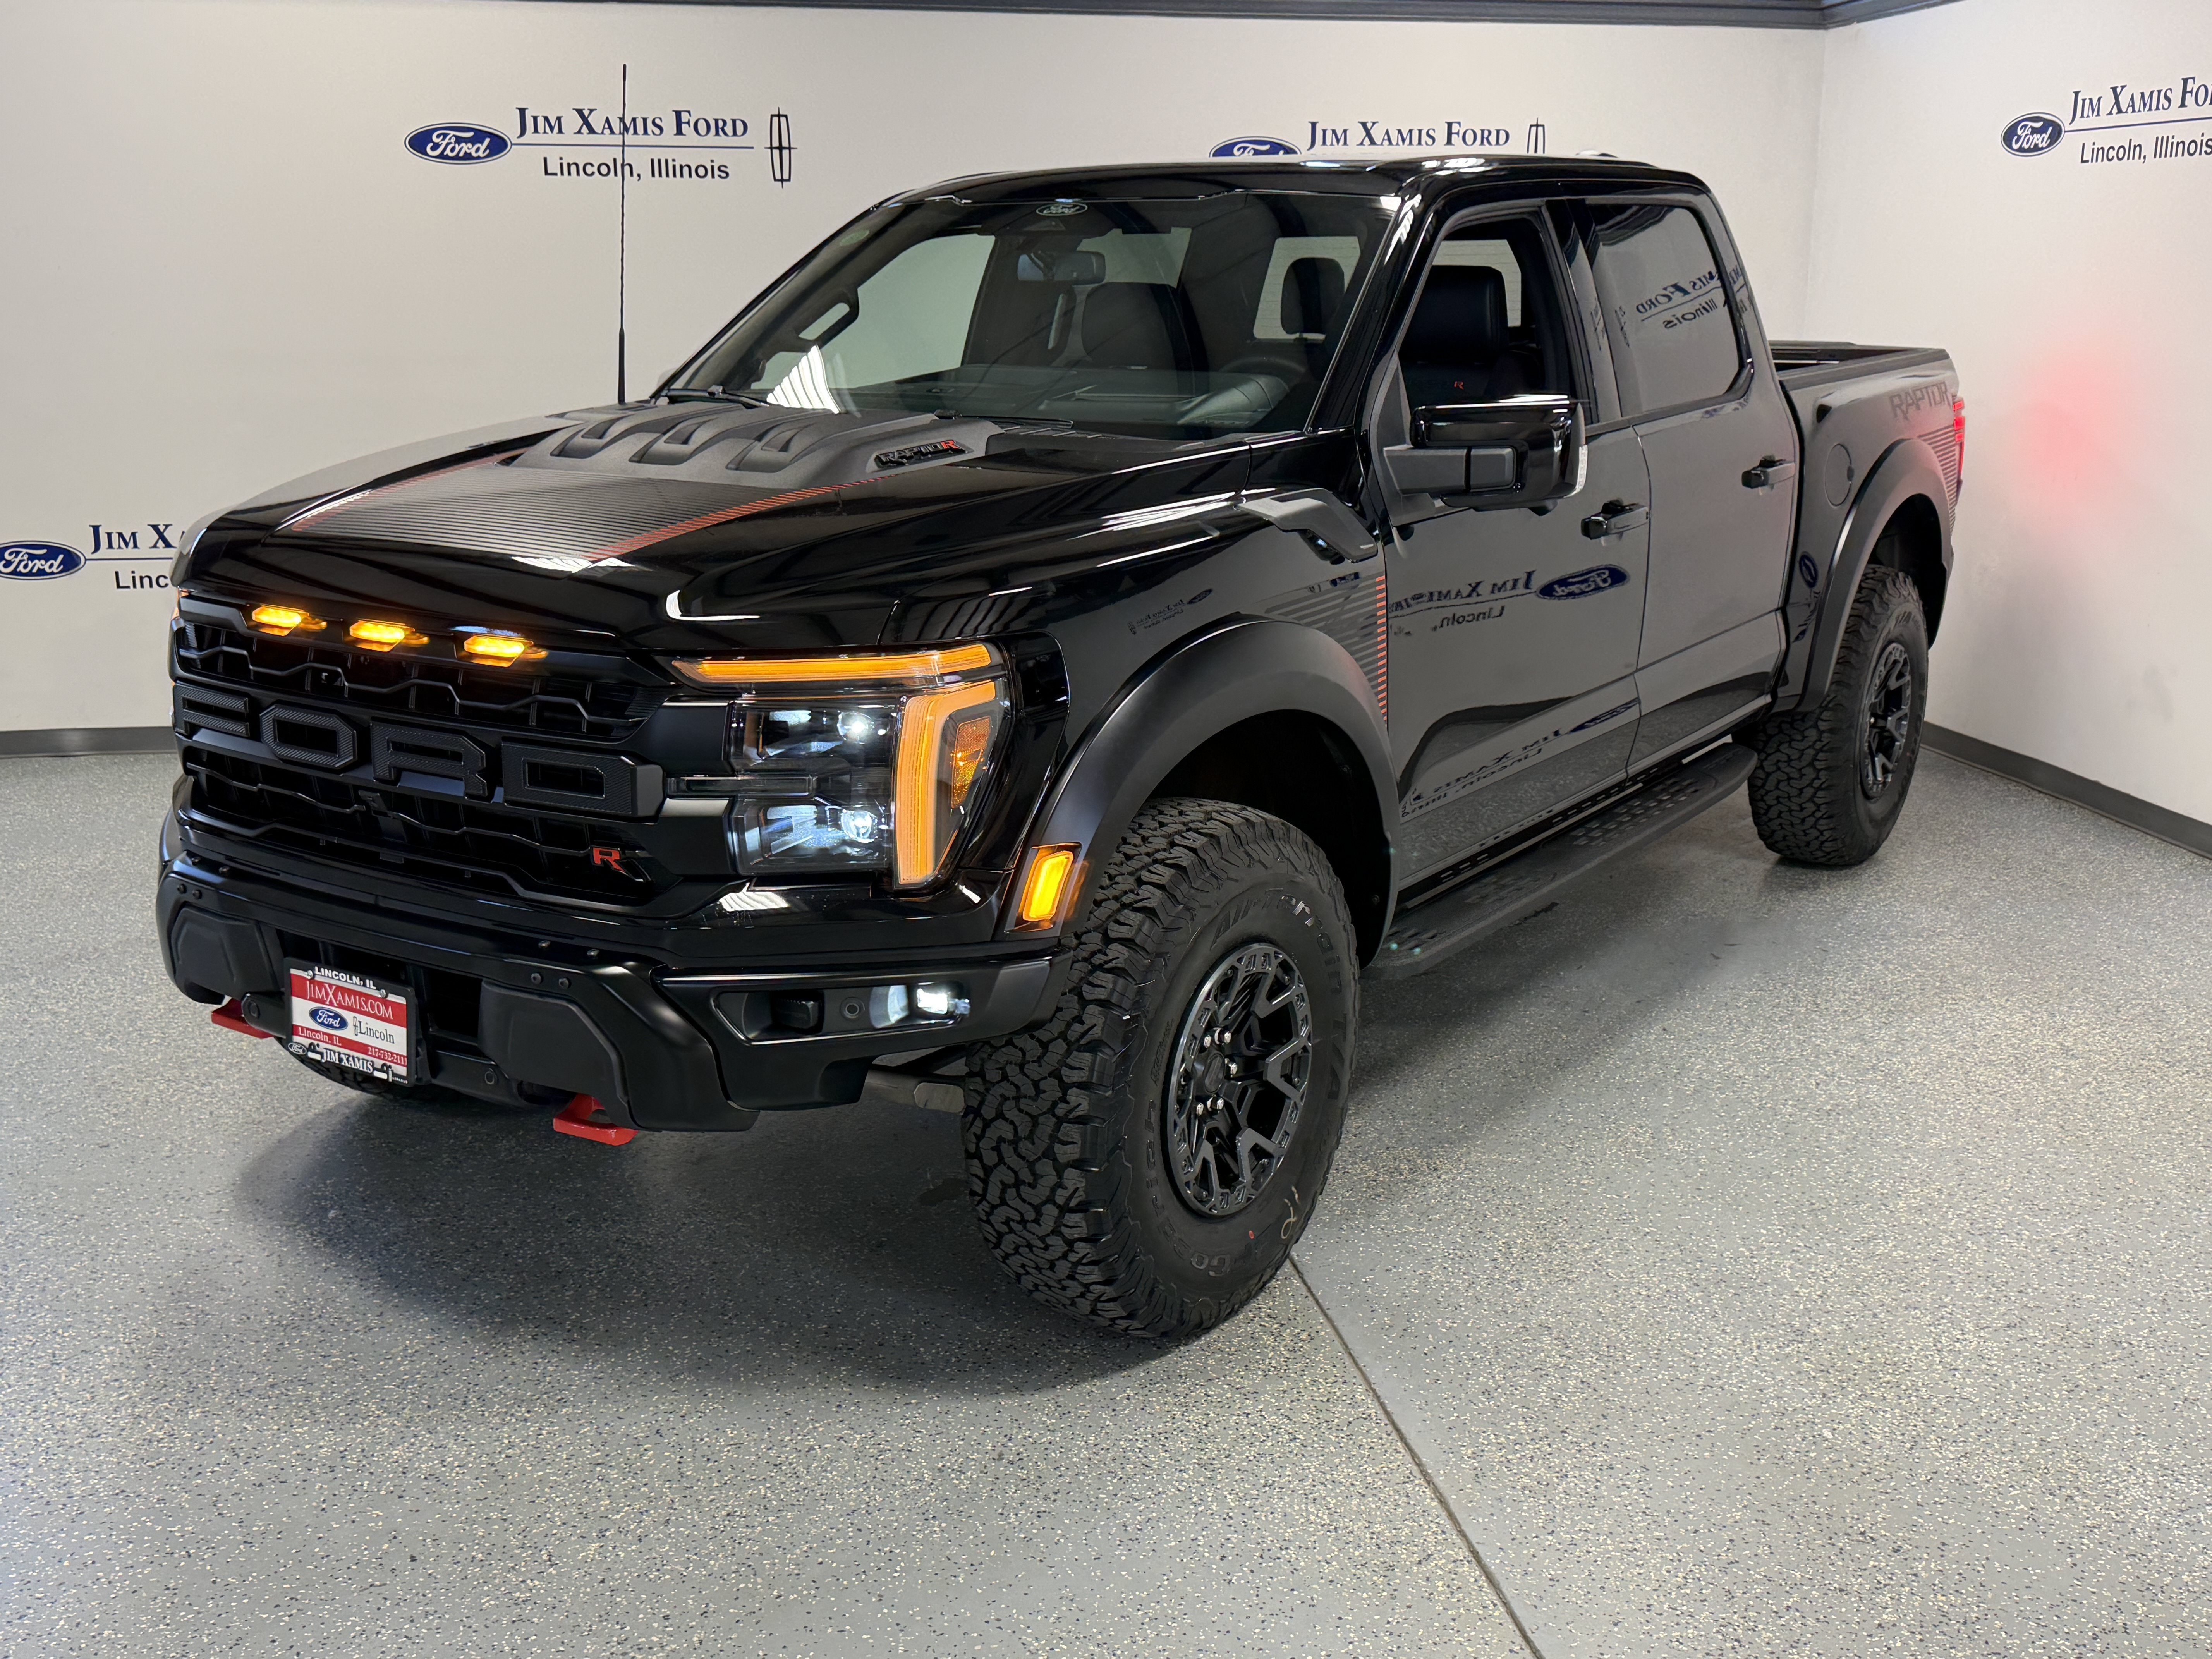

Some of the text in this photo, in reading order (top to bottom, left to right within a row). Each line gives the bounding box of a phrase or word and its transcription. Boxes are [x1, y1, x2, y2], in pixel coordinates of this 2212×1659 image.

[2069, 90, 2103, 125] JIM
[2106, 84, 2172, 115] XAMIS
[515, 107, 749, 139] JIM XAMIS FORD
[1307, 121, 1348, 151] JIM
[1356, 121, 1436, 147] XAMIS
[1444, 121, 1510, 146] FORD
[2012, 120, 2052, 149] Ford
[426, 130, 491, 158] Ford
[2080, 132, 2212, 164] Lincoln, Illinois
[543, 156, 730, 182] Lincoln, Illinois
[1889, 381, 1952, 422] RAPTOR
[874, 440, 967, 465] RAPTOR
[89, 524, 140, 555] JIM
[0, 548, 64, 574] Ford
[115, 570, 169, 589] Linc
[173, 680, 663, 818] FORD
[592, 847, 627, 873] R
[315, 966, 376, 989] LINCOLN, IL
[316, 1009, 340, 1027] Ford
[333, 1036, 342, 1046] IL
[359, 1020, 395, 1044] Lincoln
[321, 1048, 373, 1073] JIM XAMIS
[368, 1046, 407, 1066] 217-732-2111
